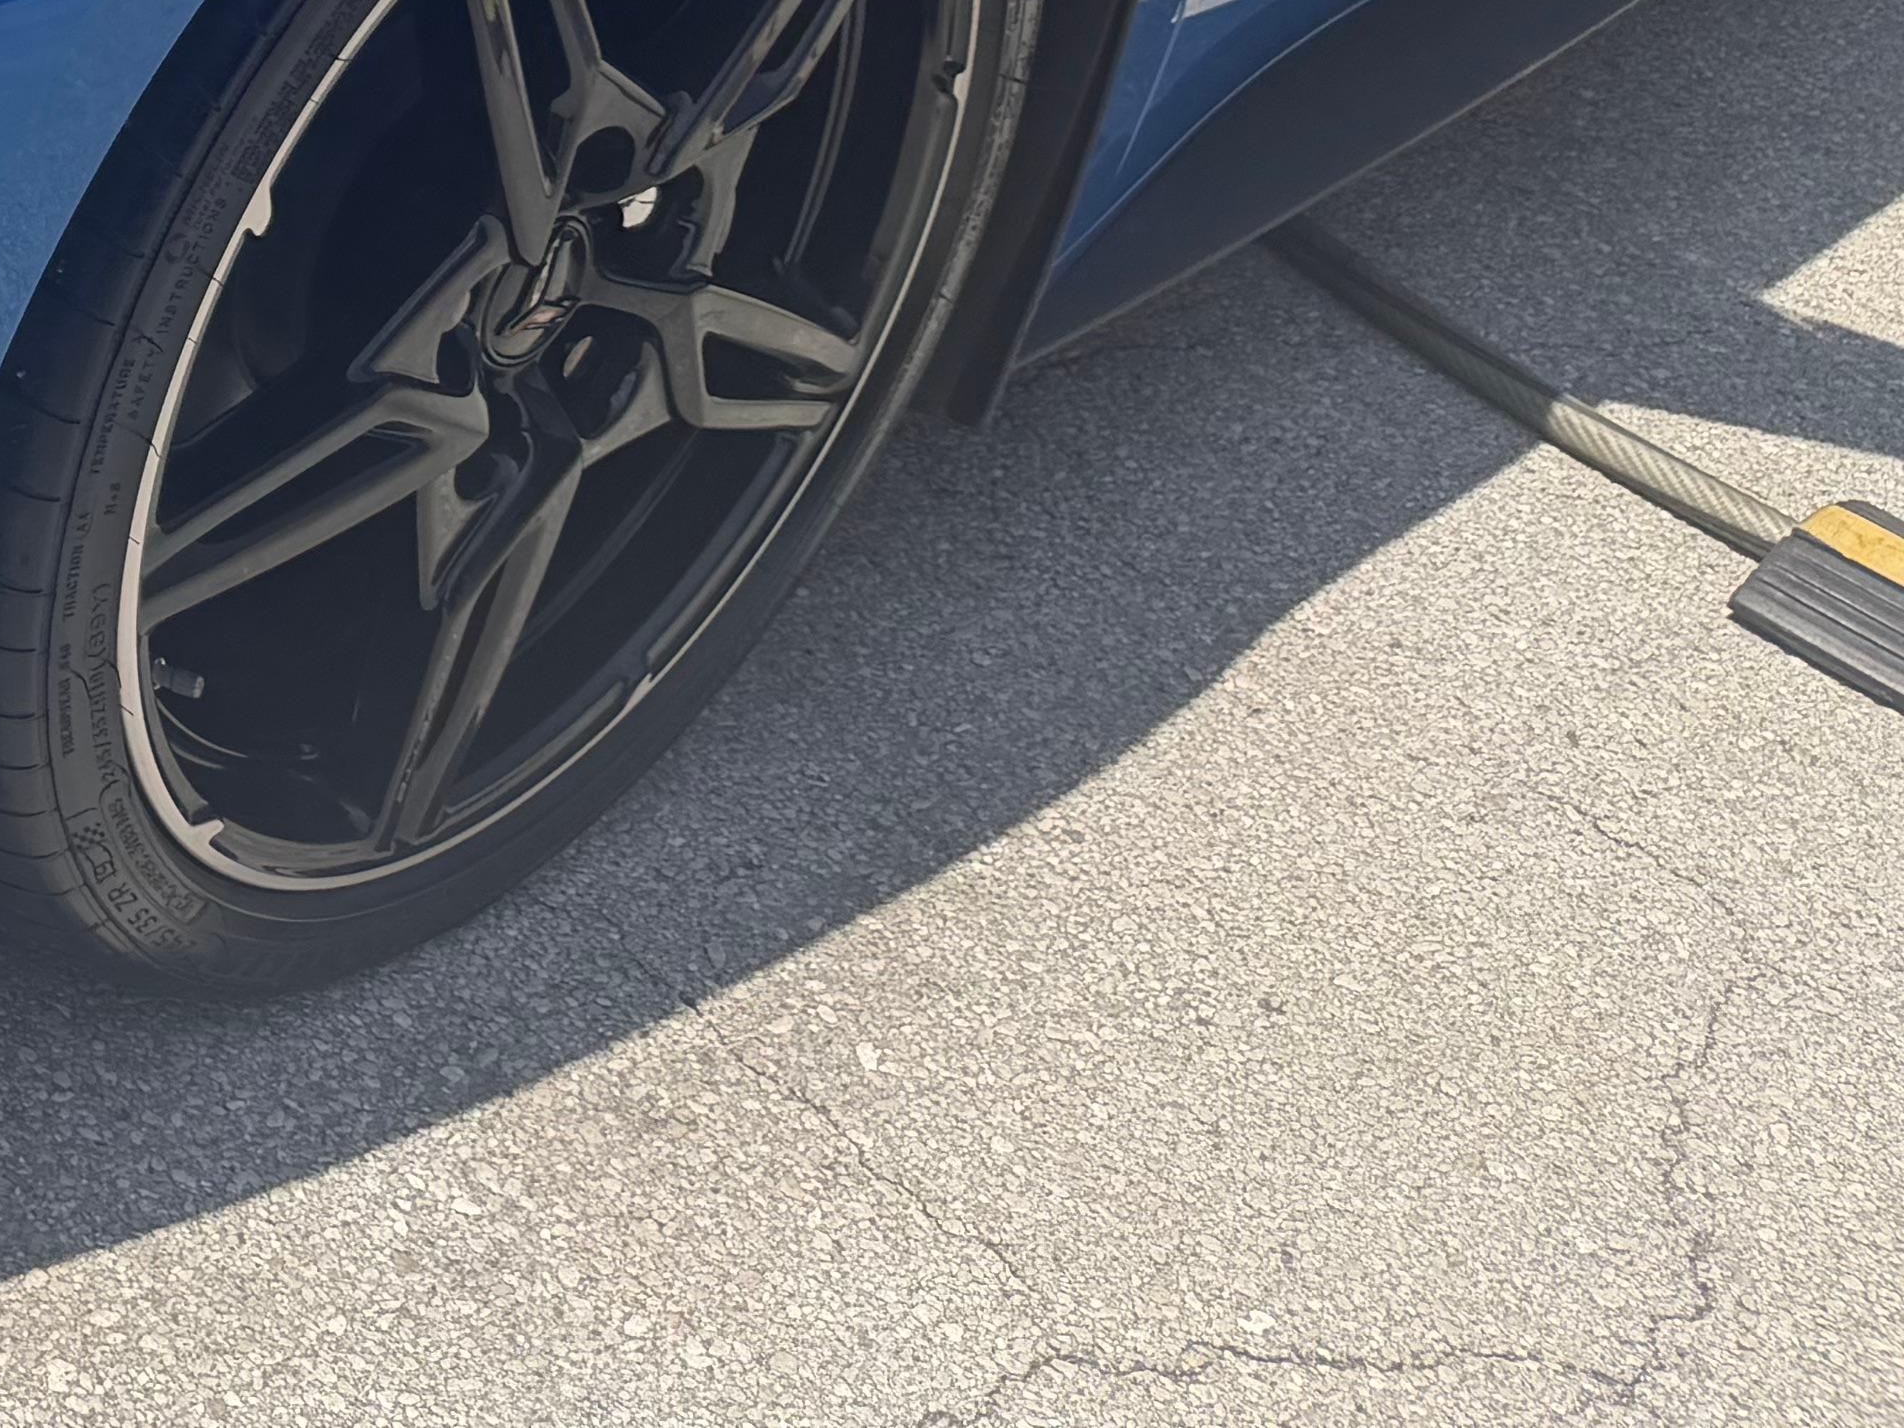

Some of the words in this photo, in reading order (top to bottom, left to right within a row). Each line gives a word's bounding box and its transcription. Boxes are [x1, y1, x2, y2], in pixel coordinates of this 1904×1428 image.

[127, 349, 160, 421] SAFETY
[156, 197, 227, 334] INSTRUCTIONS
[62, 543, 84, 622] TRACTION
[91, 357, 136, 474] TEMPERATURE
[95, 861, 116, 883] 19
[108, 882, 138, 912] ZR
